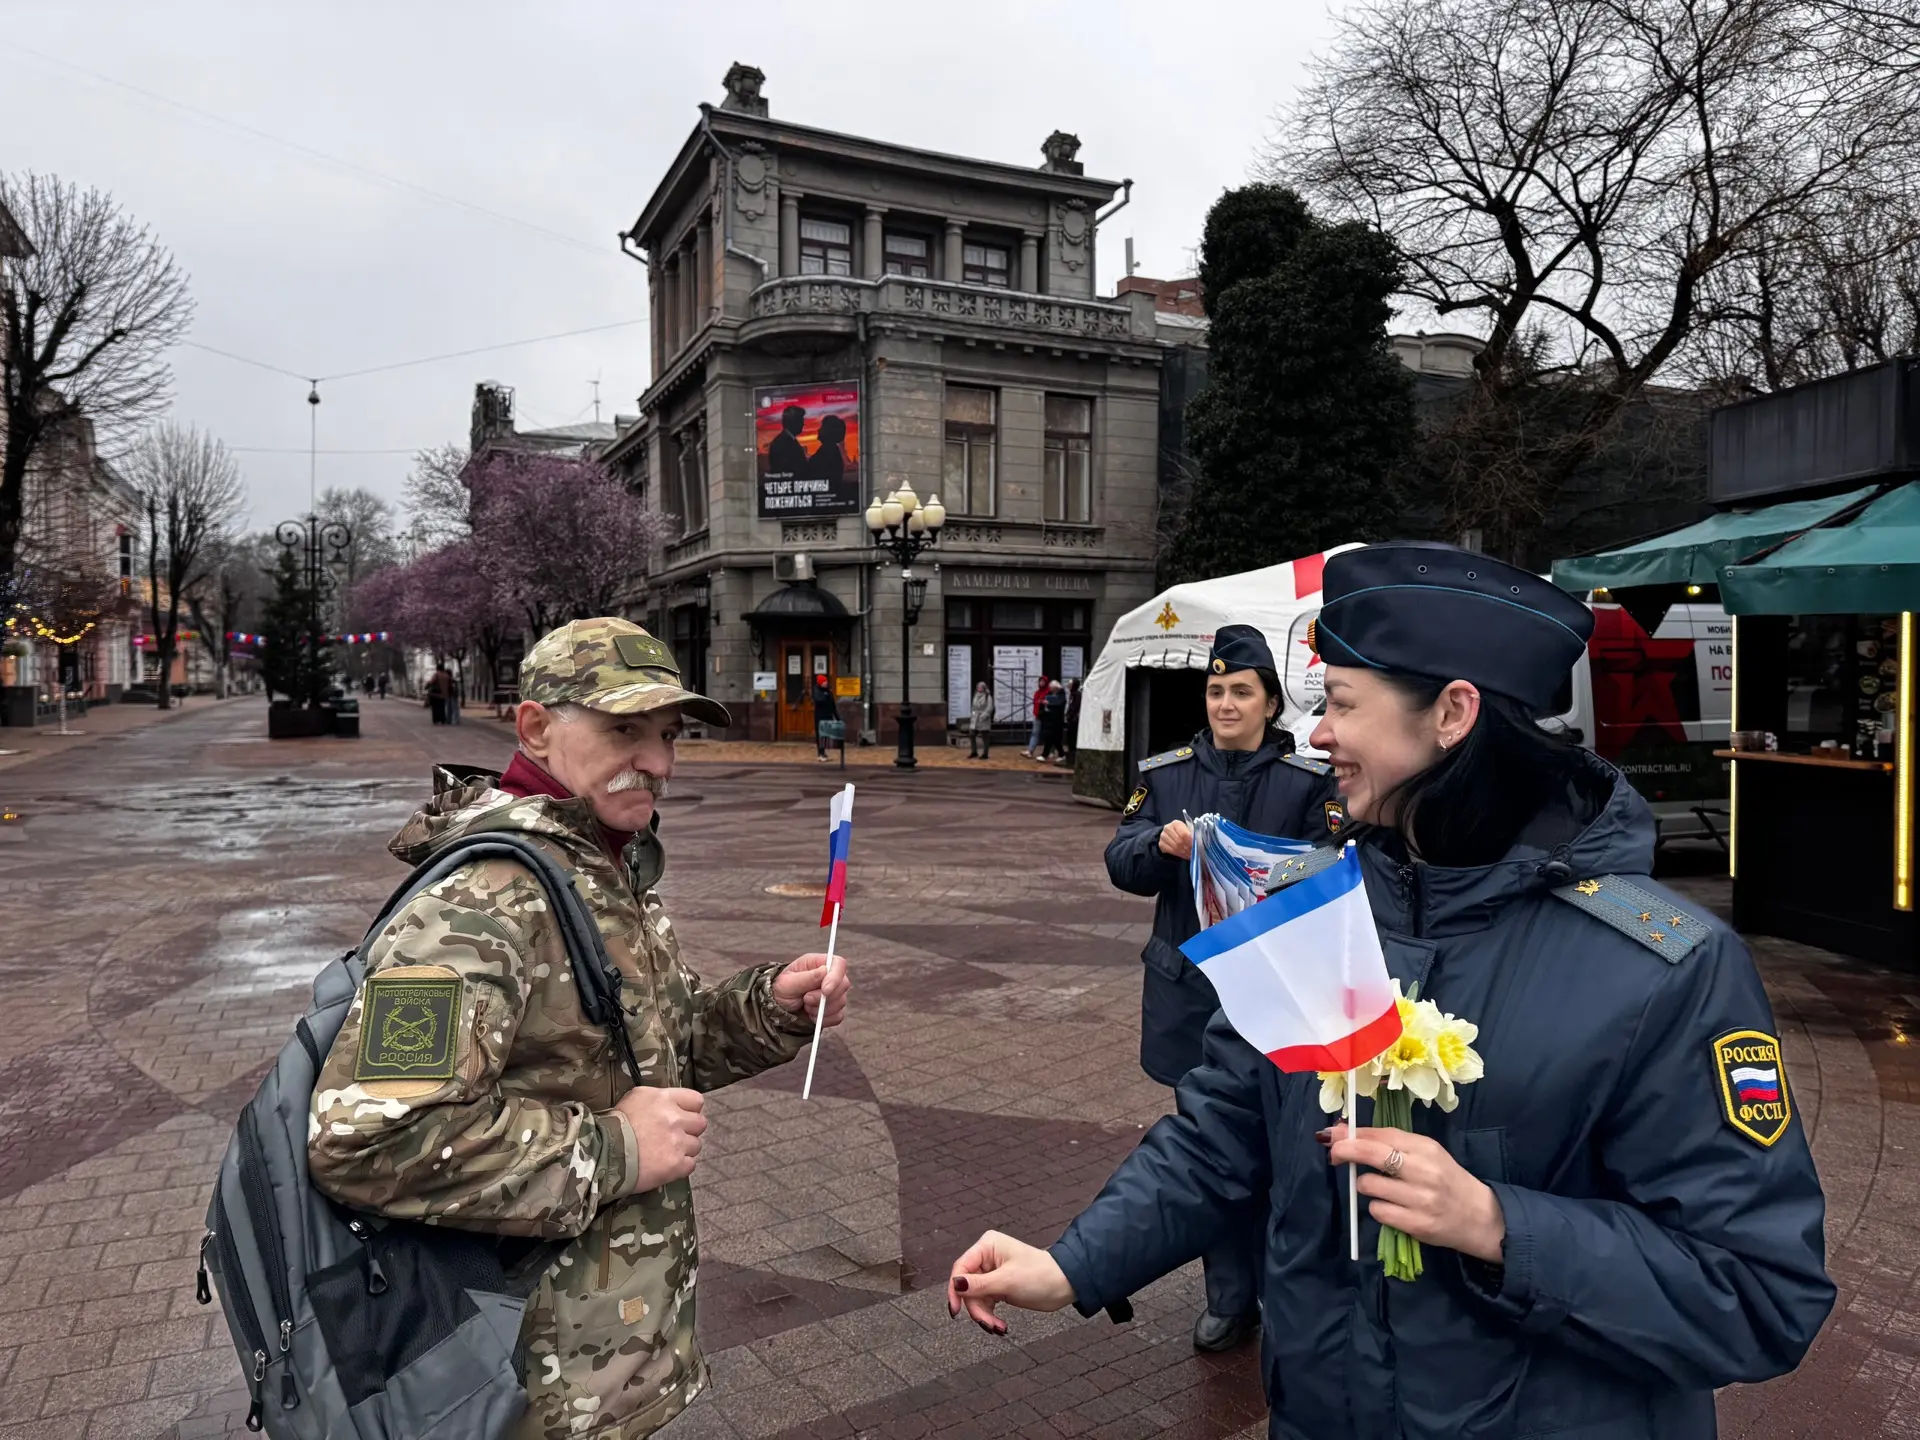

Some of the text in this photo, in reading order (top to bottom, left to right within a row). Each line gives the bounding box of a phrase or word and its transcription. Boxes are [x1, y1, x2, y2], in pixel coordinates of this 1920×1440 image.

[764, 479, 830, 494] ЧЕТЫРЕ ПРИЧИНЫ
[764, 494, 813, 509] ПОЖЕНИТЬСЯ
[953, 574, 1090, 591] КАМЕРНАЯ СЦЕНА
[1707, 625, 1732, 634] МОБИ
[1709, 644, 1724, 656] НА
[377, 989, 451, 998] МОТОСТРЕЛКОВЫЕ
[394, 997, 432, 1006] ВОЙСКА
[379, 1052, 433, 1063] РОССИЯ
[1722, 1045, 1776, 1064] РОССИЯ
[1739, 1102, 1784, 1122] ФССП
